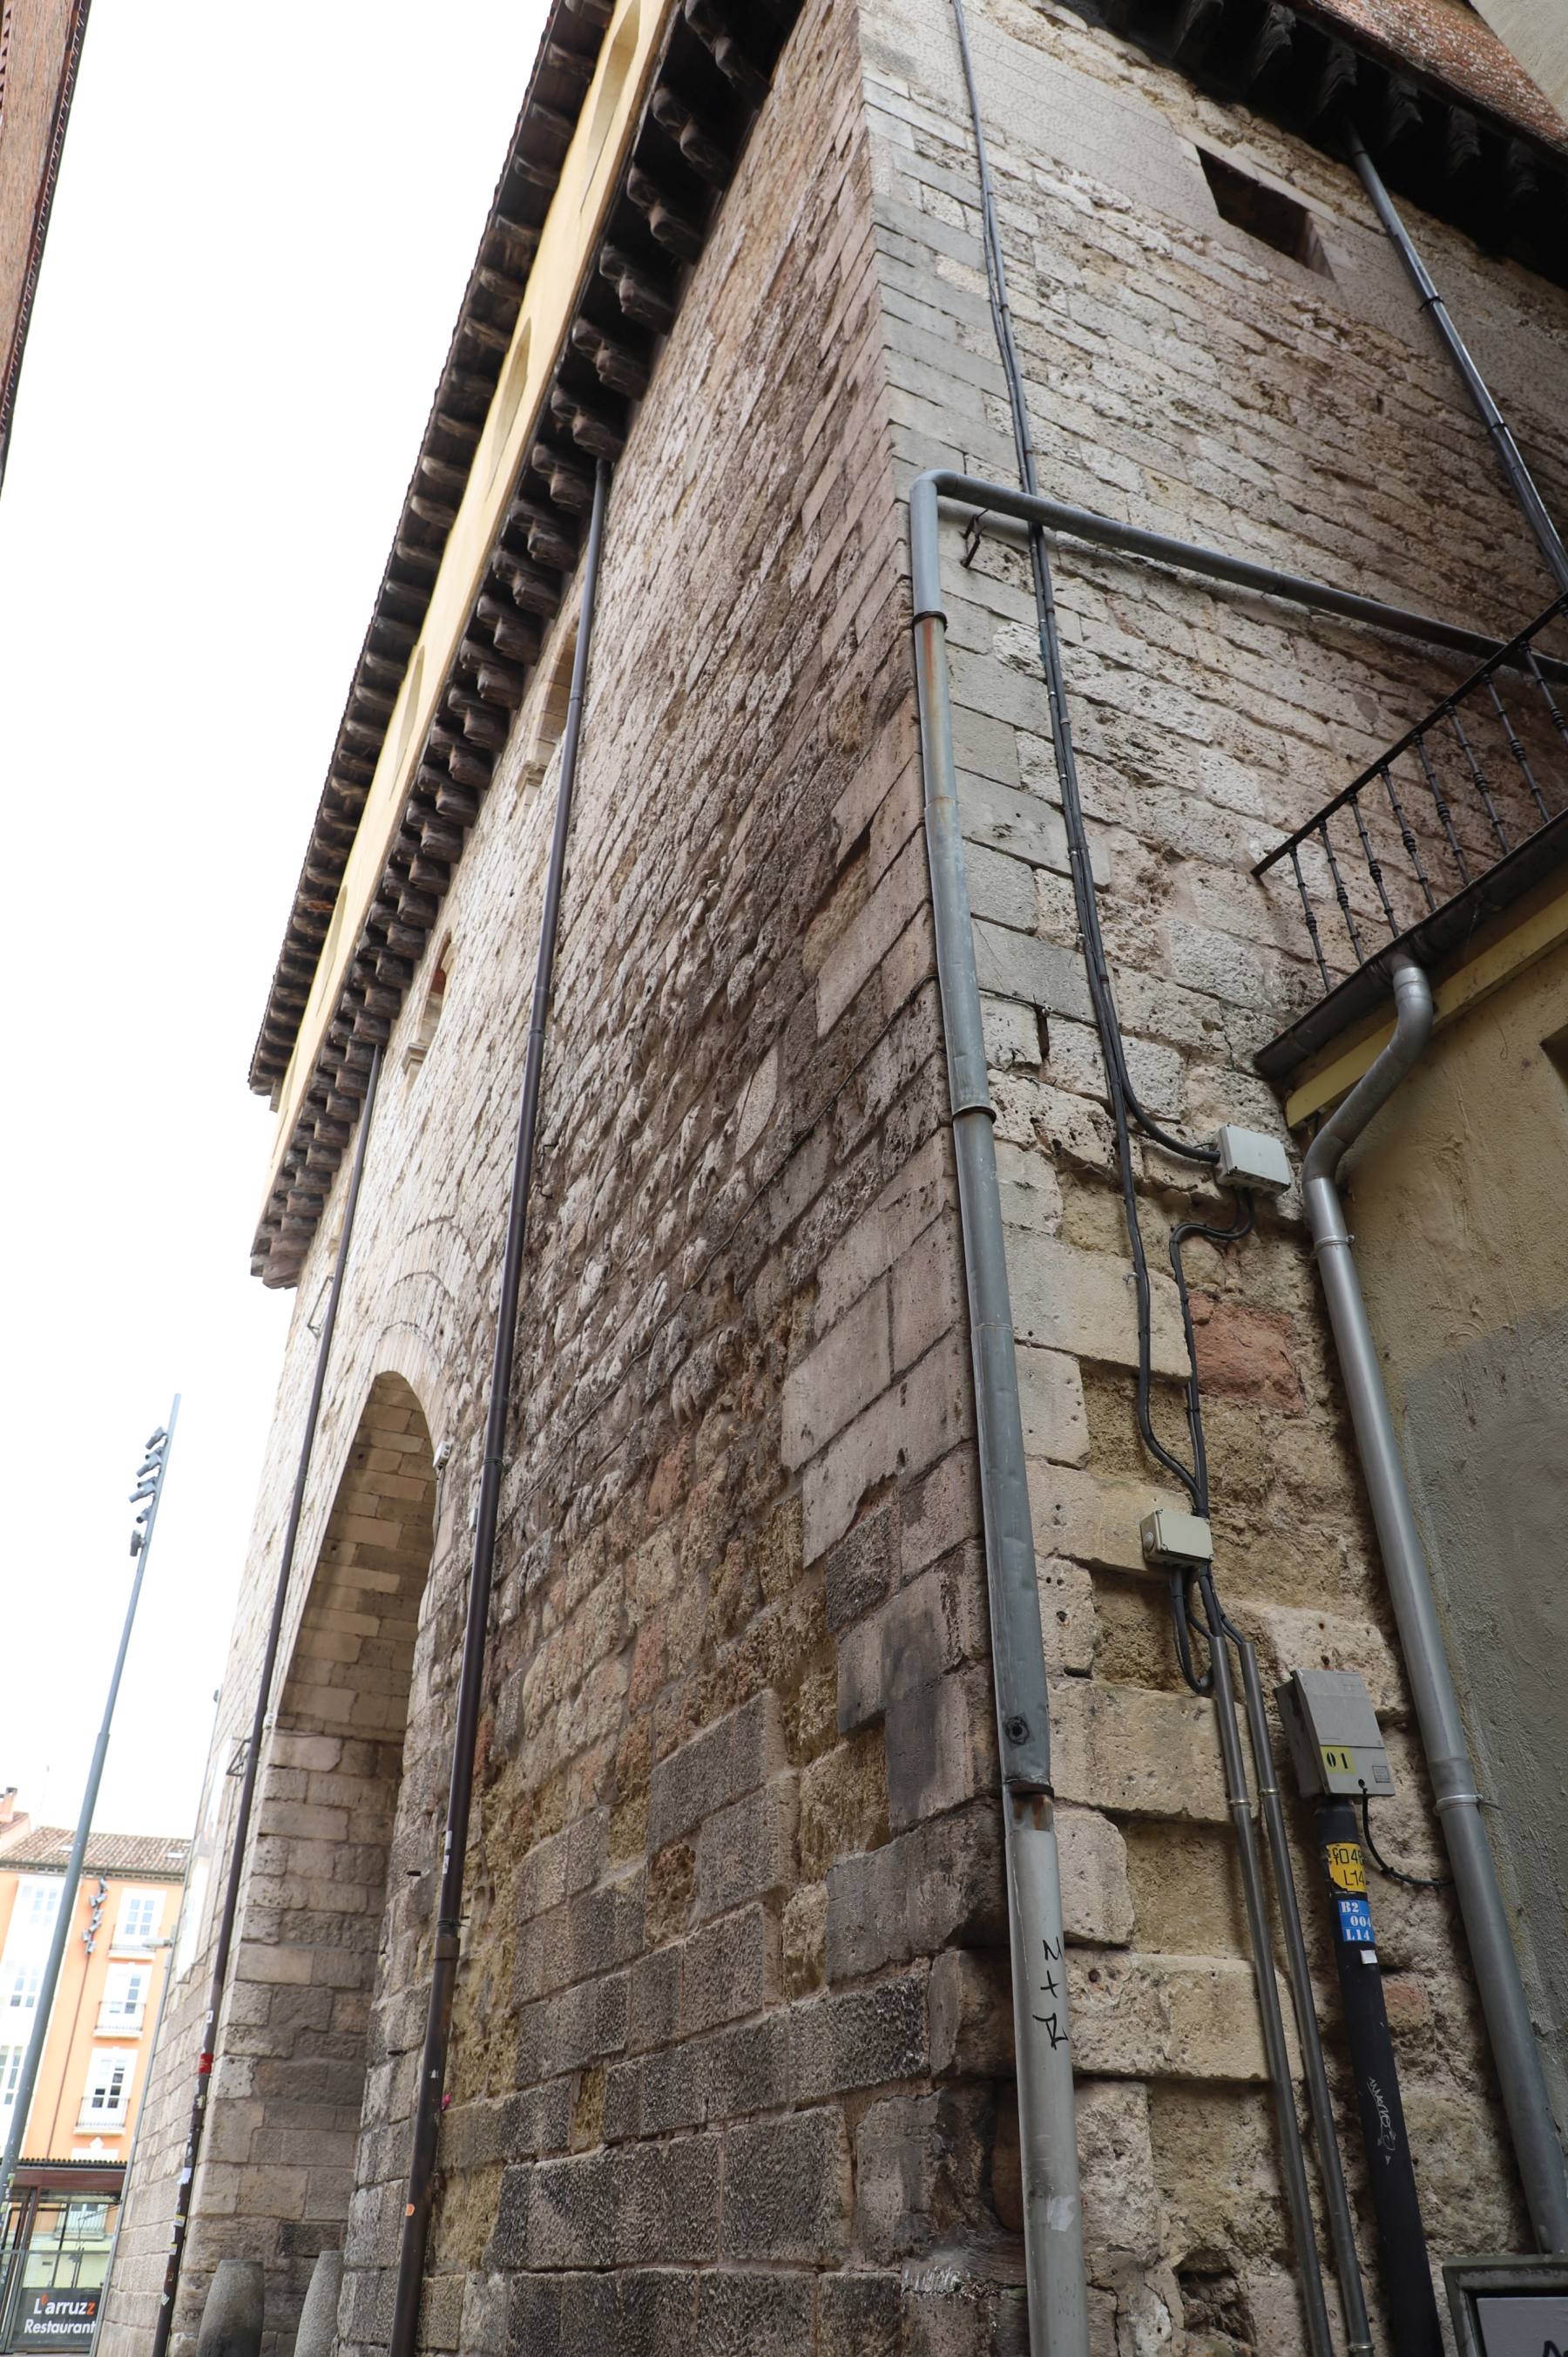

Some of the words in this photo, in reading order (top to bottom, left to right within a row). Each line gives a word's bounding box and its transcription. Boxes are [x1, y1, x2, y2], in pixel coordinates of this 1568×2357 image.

[1327, 1751, 1348, 1769] 01
[1343, 1869, 1366, 1886] L14
[1341, 1901, 1359, 1913] B2
[1345, 1928, 1370, 1940] L14
[24, 2319, 97, 2334] Restaurant
